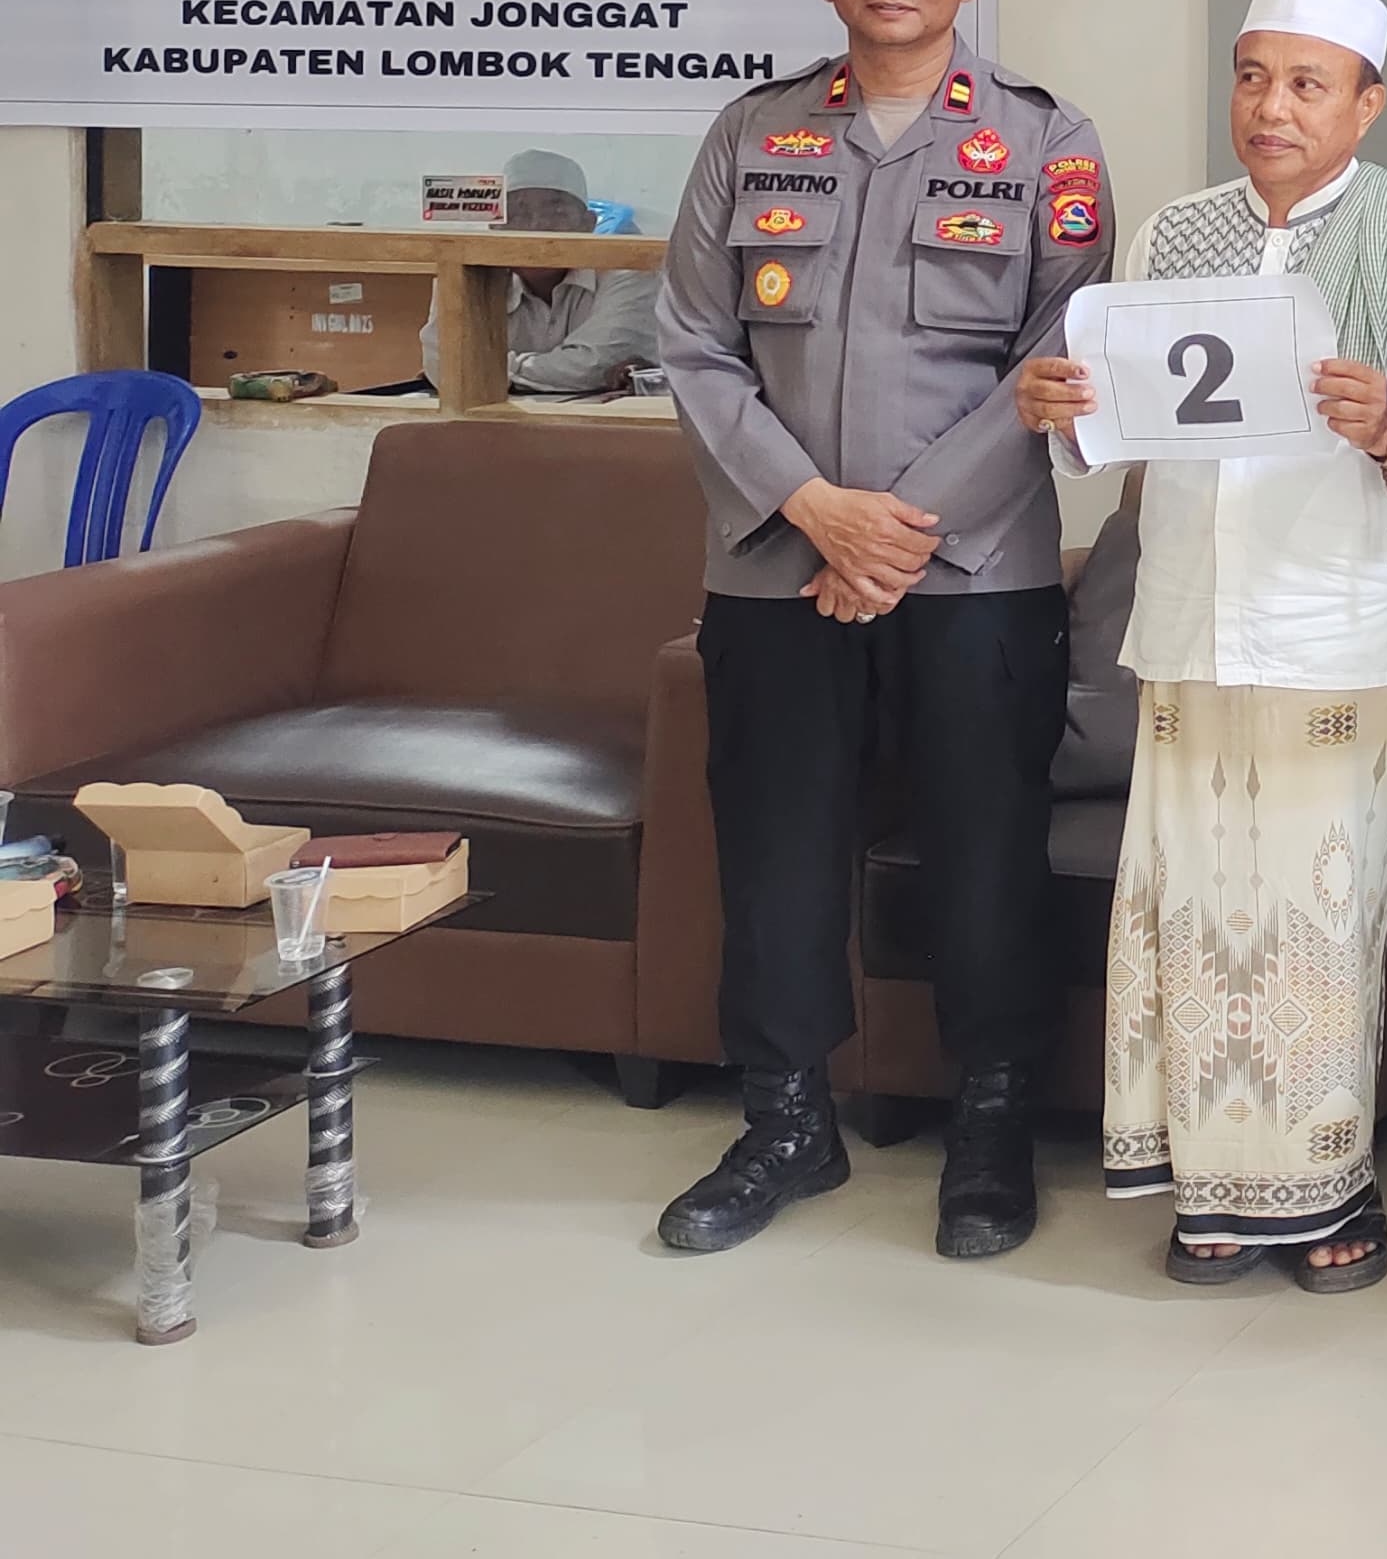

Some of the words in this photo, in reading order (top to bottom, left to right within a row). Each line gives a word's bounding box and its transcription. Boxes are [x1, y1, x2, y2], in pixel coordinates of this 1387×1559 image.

[181, 0, 455, 27] KECAMATAN
[470, 1, 688, 29] JONGGAT
[102, 48, 365, 76] KABUPATEN
[380, 48, 570, 77] LOMBOK
[585, 52, 774, 80] TENGAH
[744, 172, 837, 195] PRIYATNO
[926, 179, 1025, 201] POLRI
[1167, 333, 1244, 425] 2
